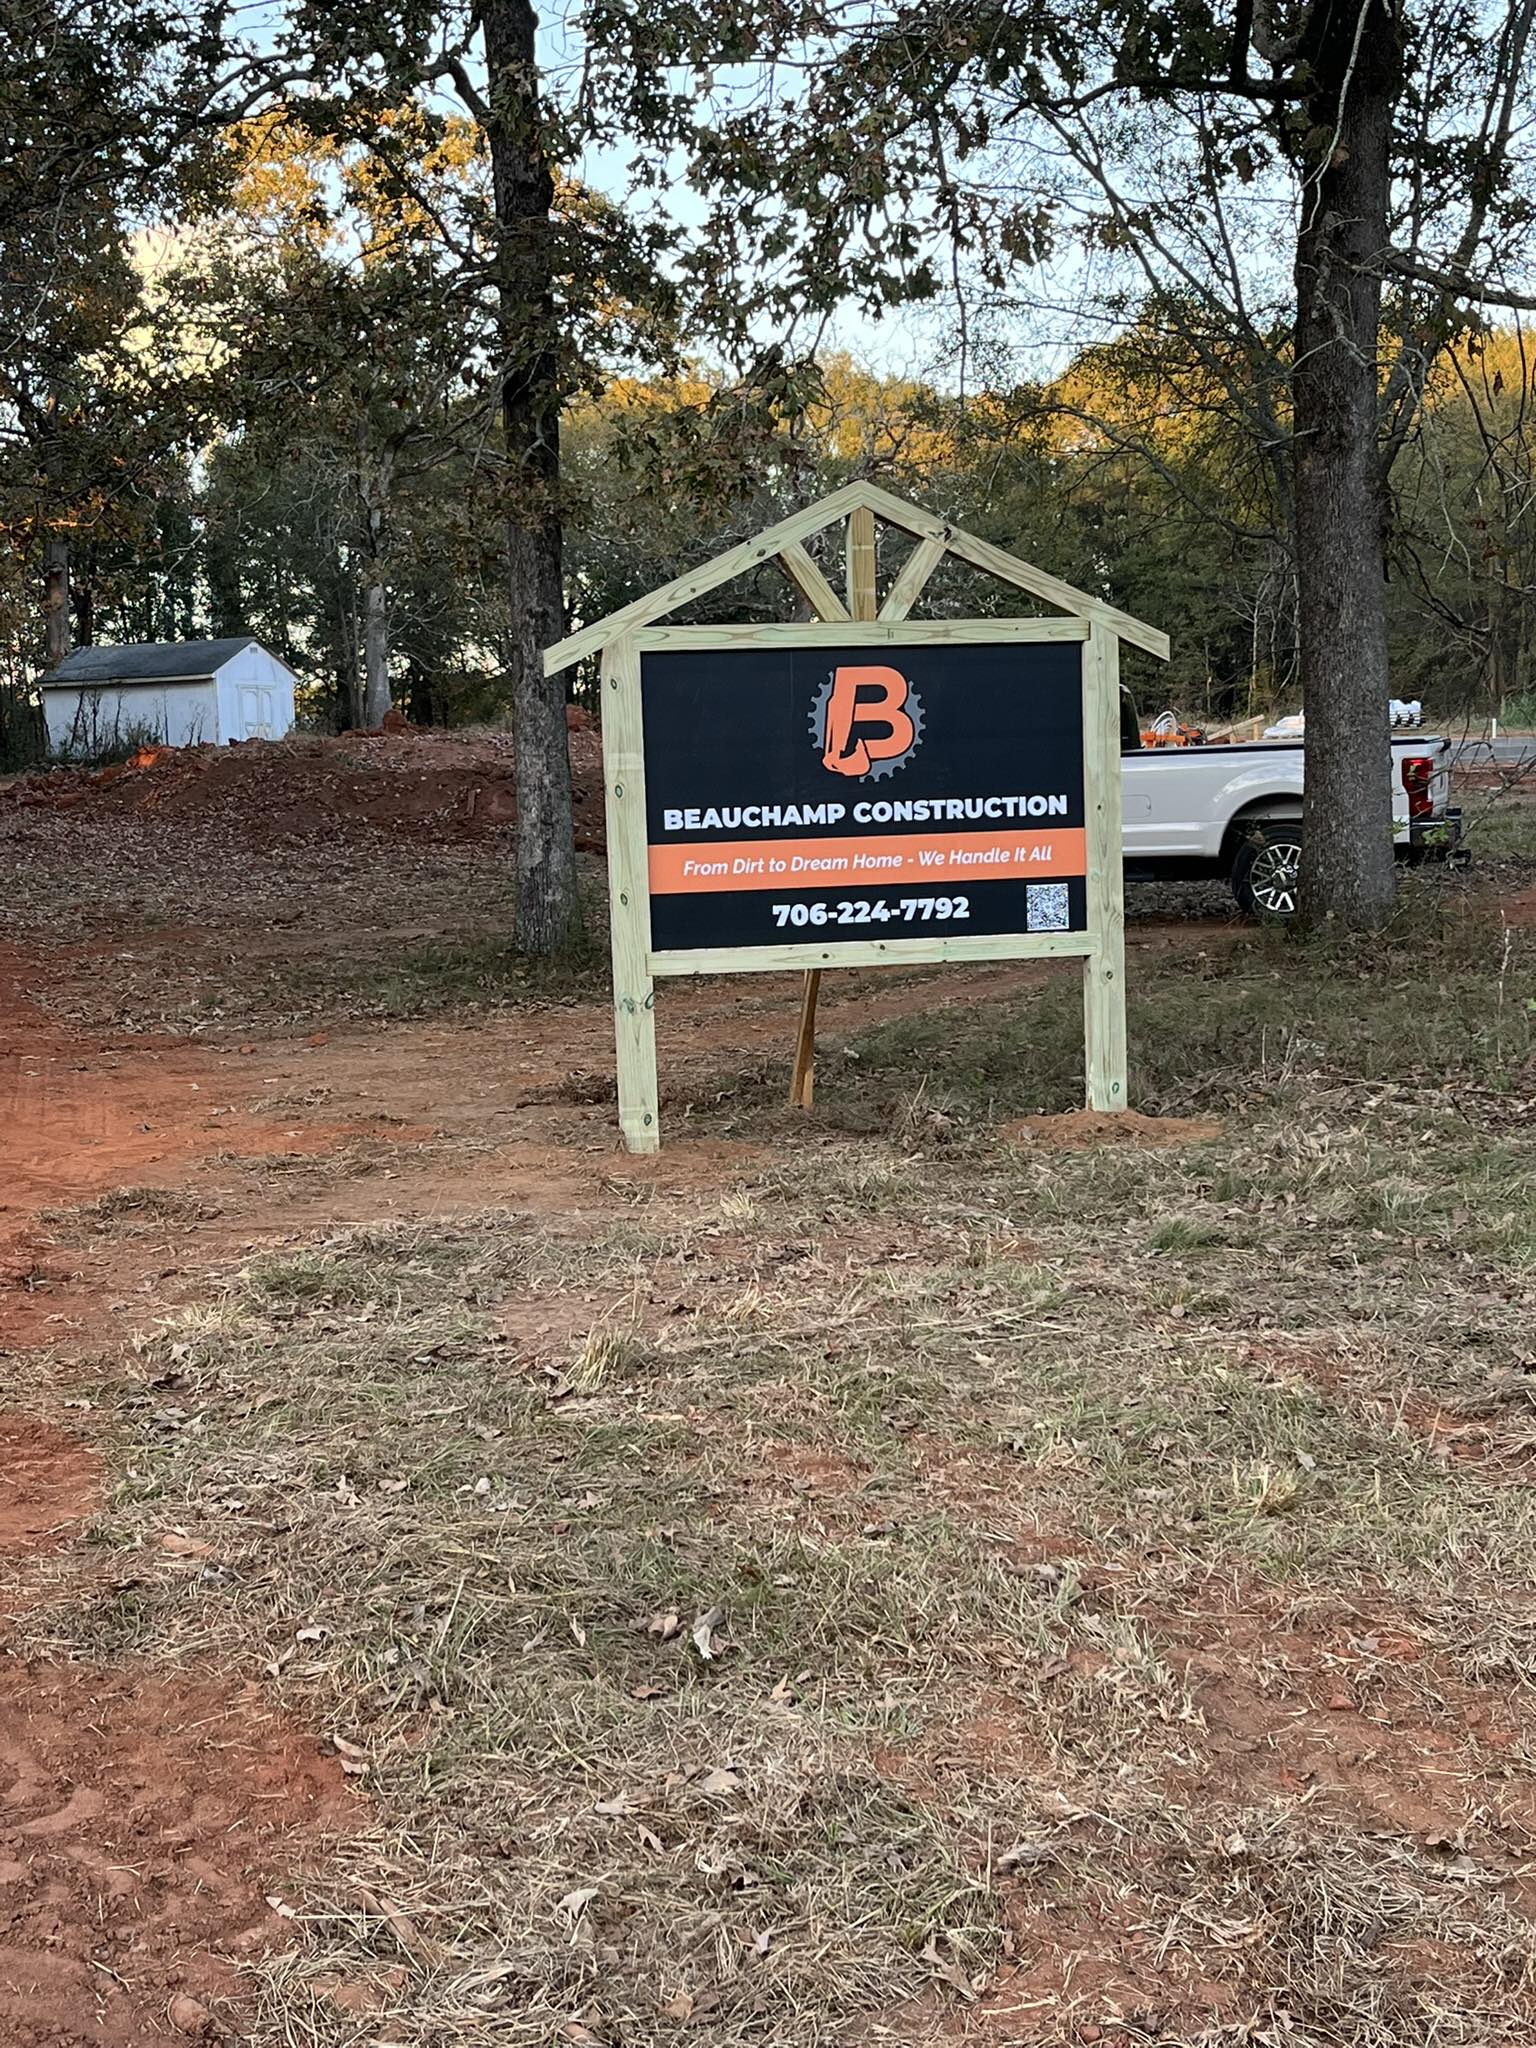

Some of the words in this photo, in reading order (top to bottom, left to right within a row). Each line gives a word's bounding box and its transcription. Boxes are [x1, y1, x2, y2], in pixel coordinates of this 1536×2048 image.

[823, 665, 914, 777] B
[664, 804, 845, 830] BEAUCHAMP
[853, 795, 1067, 823] CONSTRUCTION
[683, 860, 728, 876] From
[733, 858, 765, 873] Dirt
[770, 859, 786, 872] to
[791, 855, 848, 871] Dream
[853, 852, 902, 869] Home
[919, 850, 945, 866] We
[949, 848, 1009, 865] Handle
[1014, 847, 1025, 862] It
[1029, 846, 1052, 861] All
[772, 897, 969, 927] 706-224-7792
